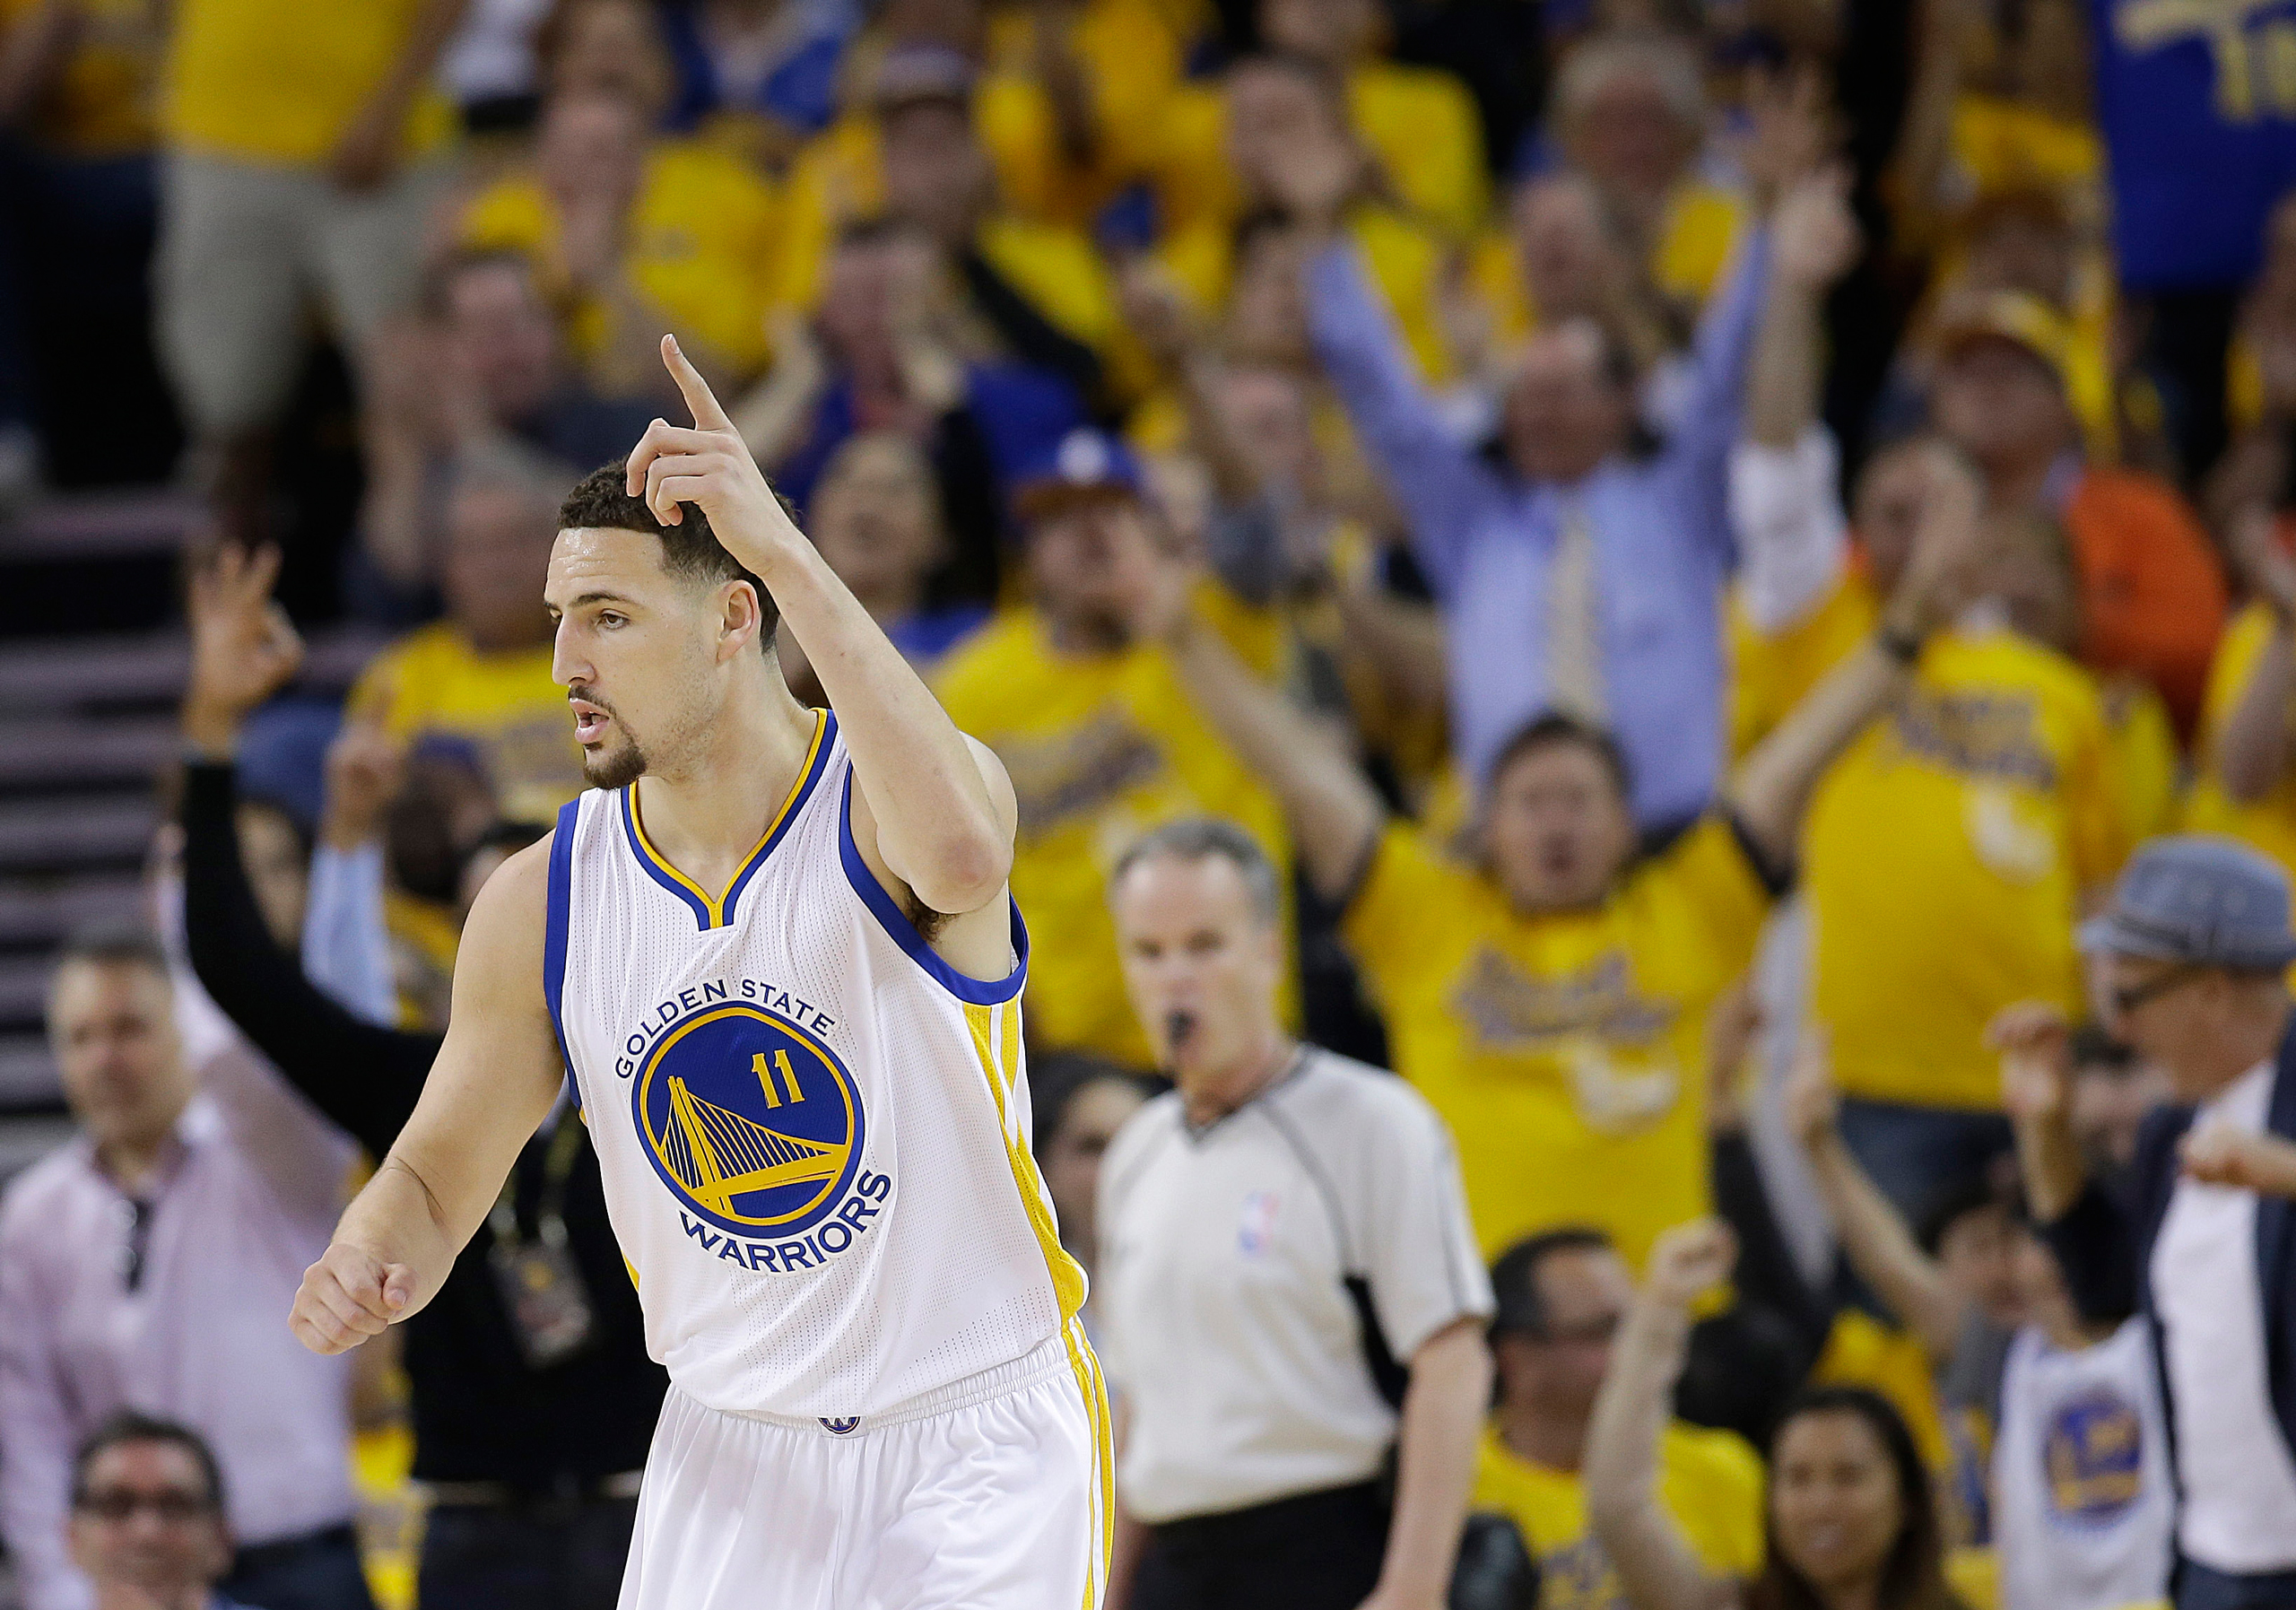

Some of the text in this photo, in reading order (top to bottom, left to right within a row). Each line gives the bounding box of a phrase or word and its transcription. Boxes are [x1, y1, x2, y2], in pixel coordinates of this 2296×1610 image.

[615, 979, 835, 1079] GOLDEN STATE
[752, 1049, 805, 1109] 11
[679, 1170, 891, 1272] WARRIORS
